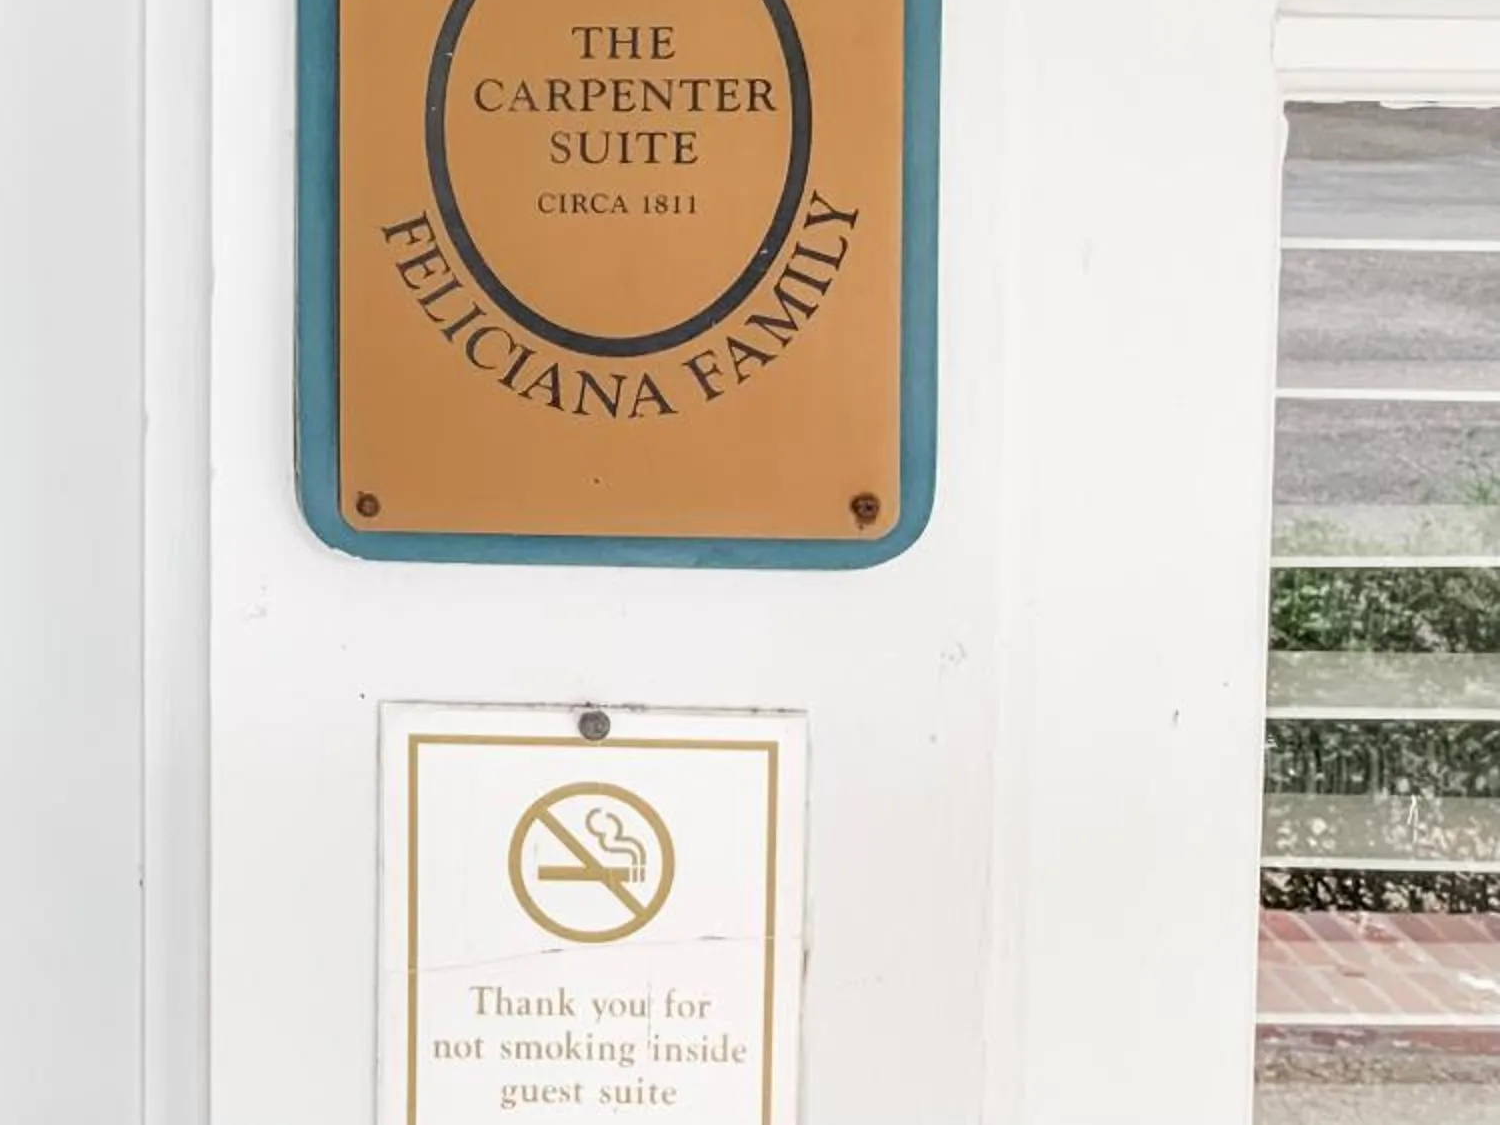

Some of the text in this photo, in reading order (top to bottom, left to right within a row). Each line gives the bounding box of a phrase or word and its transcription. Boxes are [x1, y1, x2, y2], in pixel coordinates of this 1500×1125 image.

[571, 26, 677, 60] THE
[473, 78, 778, 113] CARPENTER
[549, 126, 699, 165] SUITE
[537, 192, 697, 215] CIRCA 1811
[381, 190, 859, 418] FELICIANA FAMILY
[469, 986, 712, 1024] Thank you for
[433, 1030, 748, 1067] not smoking inside
[500, 1077, 678, 1111] guest suite
